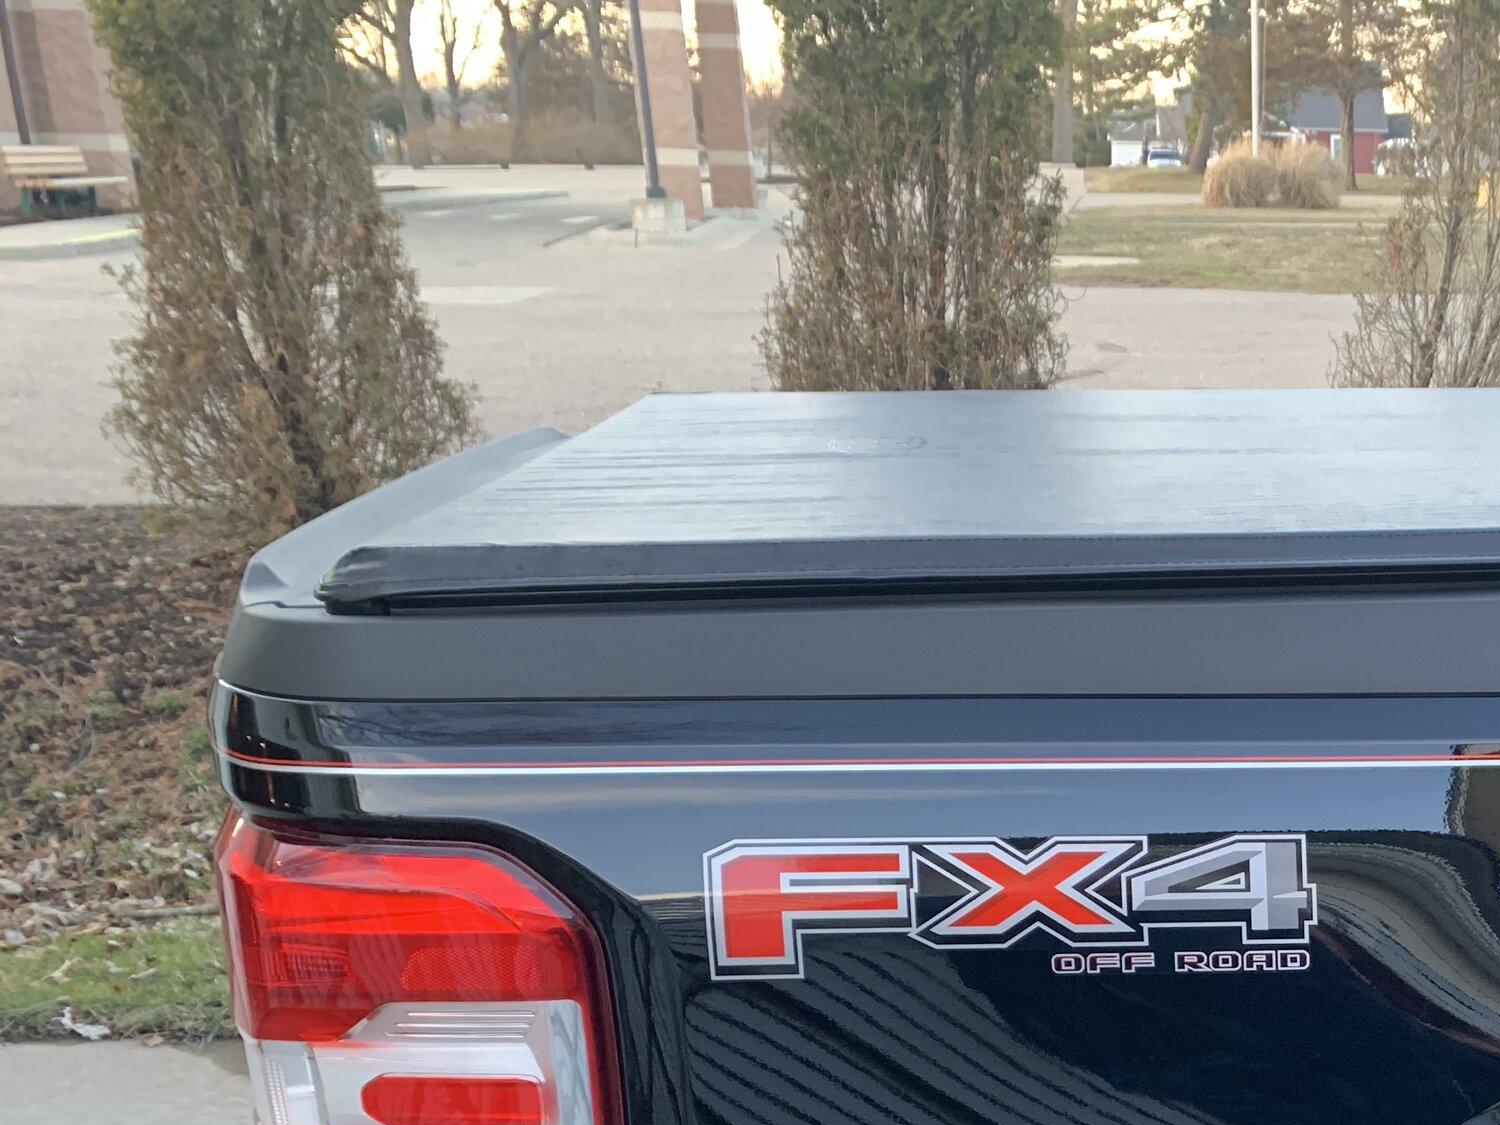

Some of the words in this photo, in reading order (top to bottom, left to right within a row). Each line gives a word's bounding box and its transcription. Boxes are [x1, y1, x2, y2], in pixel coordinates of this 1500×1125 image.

[703, 834, 1317, 980] FX4
[1051, 952, 1155, 975] OFF
[1174, 949, 1311, 973] ROAD
